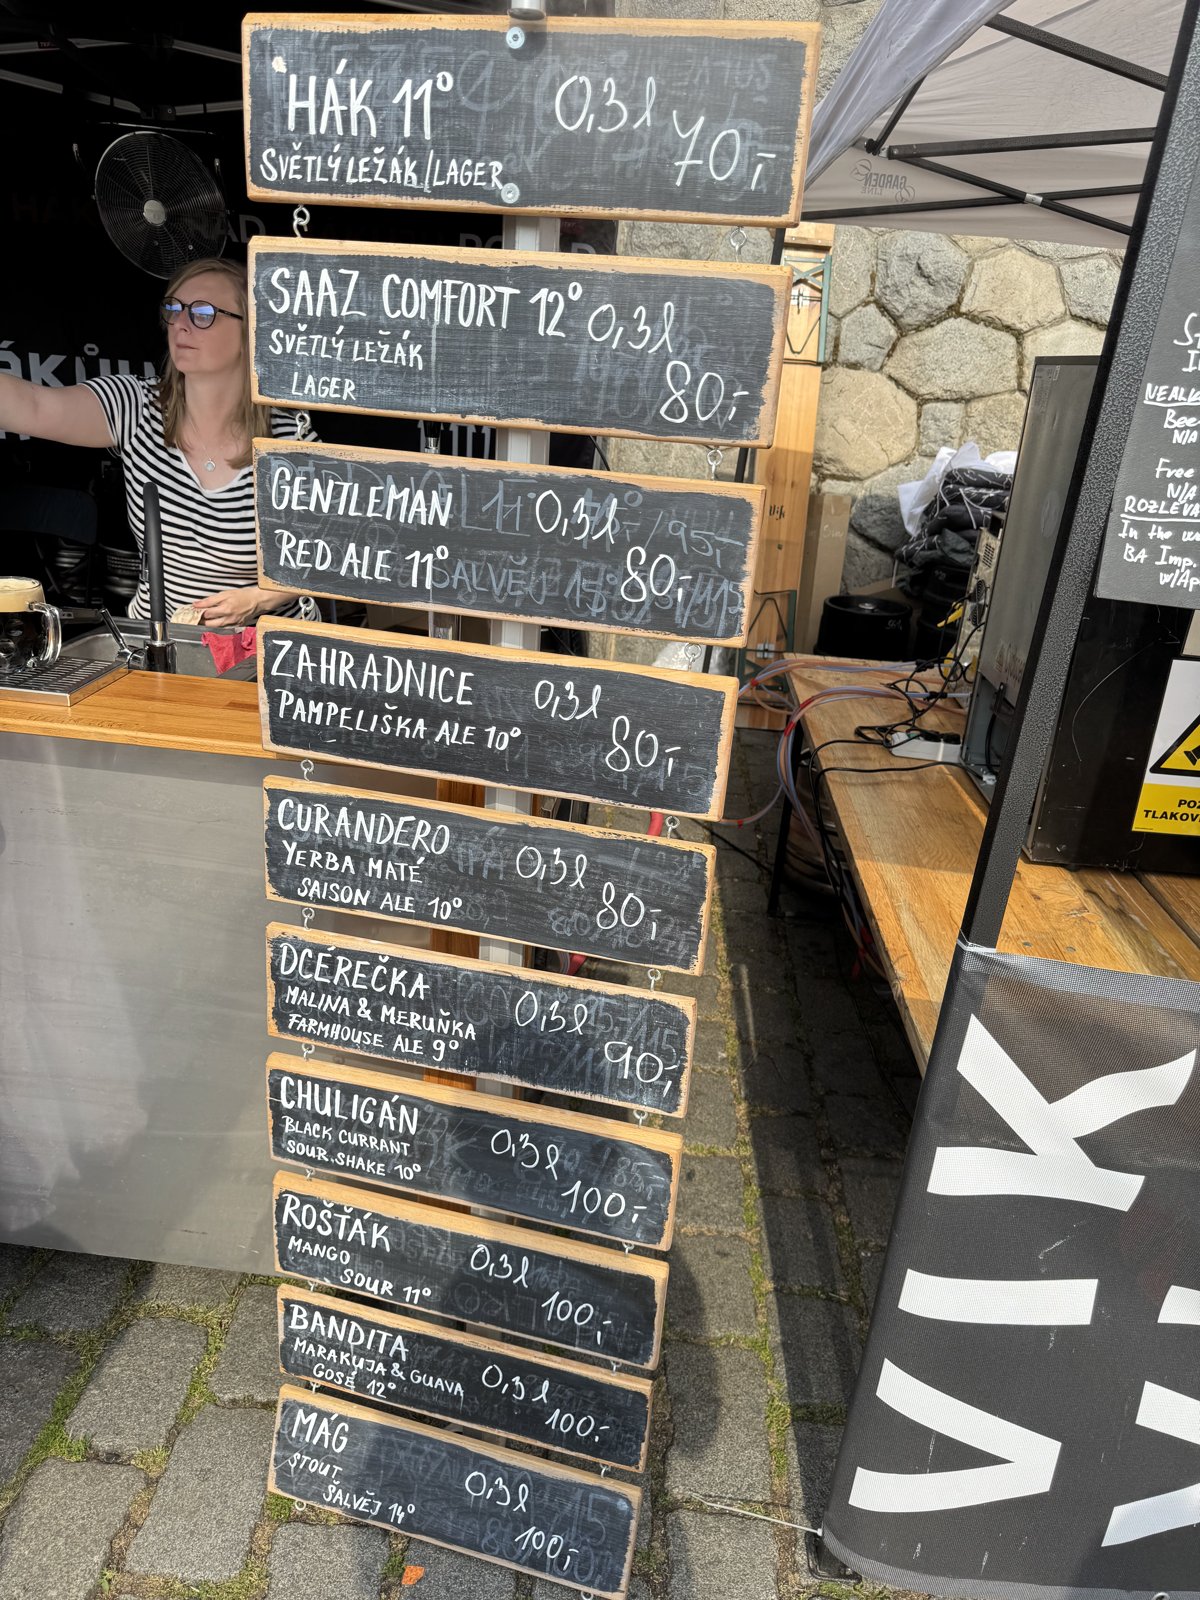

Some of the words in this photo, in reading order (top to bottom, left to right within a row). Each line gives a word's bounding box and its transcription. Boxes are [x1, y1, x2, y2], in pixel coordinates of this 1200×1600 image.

[287, 58, 377, 138] HÁK
[259, 142, 340, 182] SVĚTLÝ
[267, 267, 366, 319] SAAZ
[382, 273, 520, 329] COMFORT
[268, 322, 345, 362] SVĚTLÝ
[352, 329, 424, 371] LEŽÁK
[291, 371, 356, 401] LAGER
[1155, 457, 1195, 479] Free
[271, 466, 453, 527] GENTLEMAN
[1118, 519, 1138, 540] In
[273, 529, 332, 571] RED
[340, 542, 392, 582] ALE
[1123, 542, 1149, 564] BA
[1155, 545, 1197, 573] Imp.
[1159, 568, 1200, 592] w/Ap
[271, 639, 475, 706] ZAHRADNICE
[274, 688, 428, 740] PAMPELIŠKA
[434, 718, 476, 746] ALE
[1143, 809, 1200, 823] TLAKOV
[281, 839, 356, 876] YERBA
[366, 856, 426, 884] MATÉ
[297, 877, 371, 907] SAISON
[379, 891, 416, 914] ALE
[279, 942, 431, 1001] DCÉREČKA
[284, 985, 351, 1018] MALINA
[356, 997, 374, 1022] &
[380, 1004, 477, 1041] MERUŇKA
[287, 1013, 385, 1048] FARMHOUSE
[392, 1034, 424, 1055] ALE
[280, 1076, 419, 1136] CHULIGÁN
[281, 1115, 332, 1140] BLACK
[338, 1129, 411, 1157] CURRANT
[334, 1151, 386, 1177] SHAKE
[282, 1193, 391, 1253] ROŠŤÁK
[287, 1235, 350, 1265] MANGO
[339, 1268, 393, 1297] SOUR
[288, 1303, 409, 1362] BANDITA
[293, 1336, 387, 1377] MARAKUJA
[391, 1363, 406, 1381] &
[410, 1369, 465, 1398] GUAVA
[291, 1408, 349, 1454] MÁG
[288, 1451, 343, 1479] STOUT
[322, 1479, 382, 1511] ŠALVĚJ
